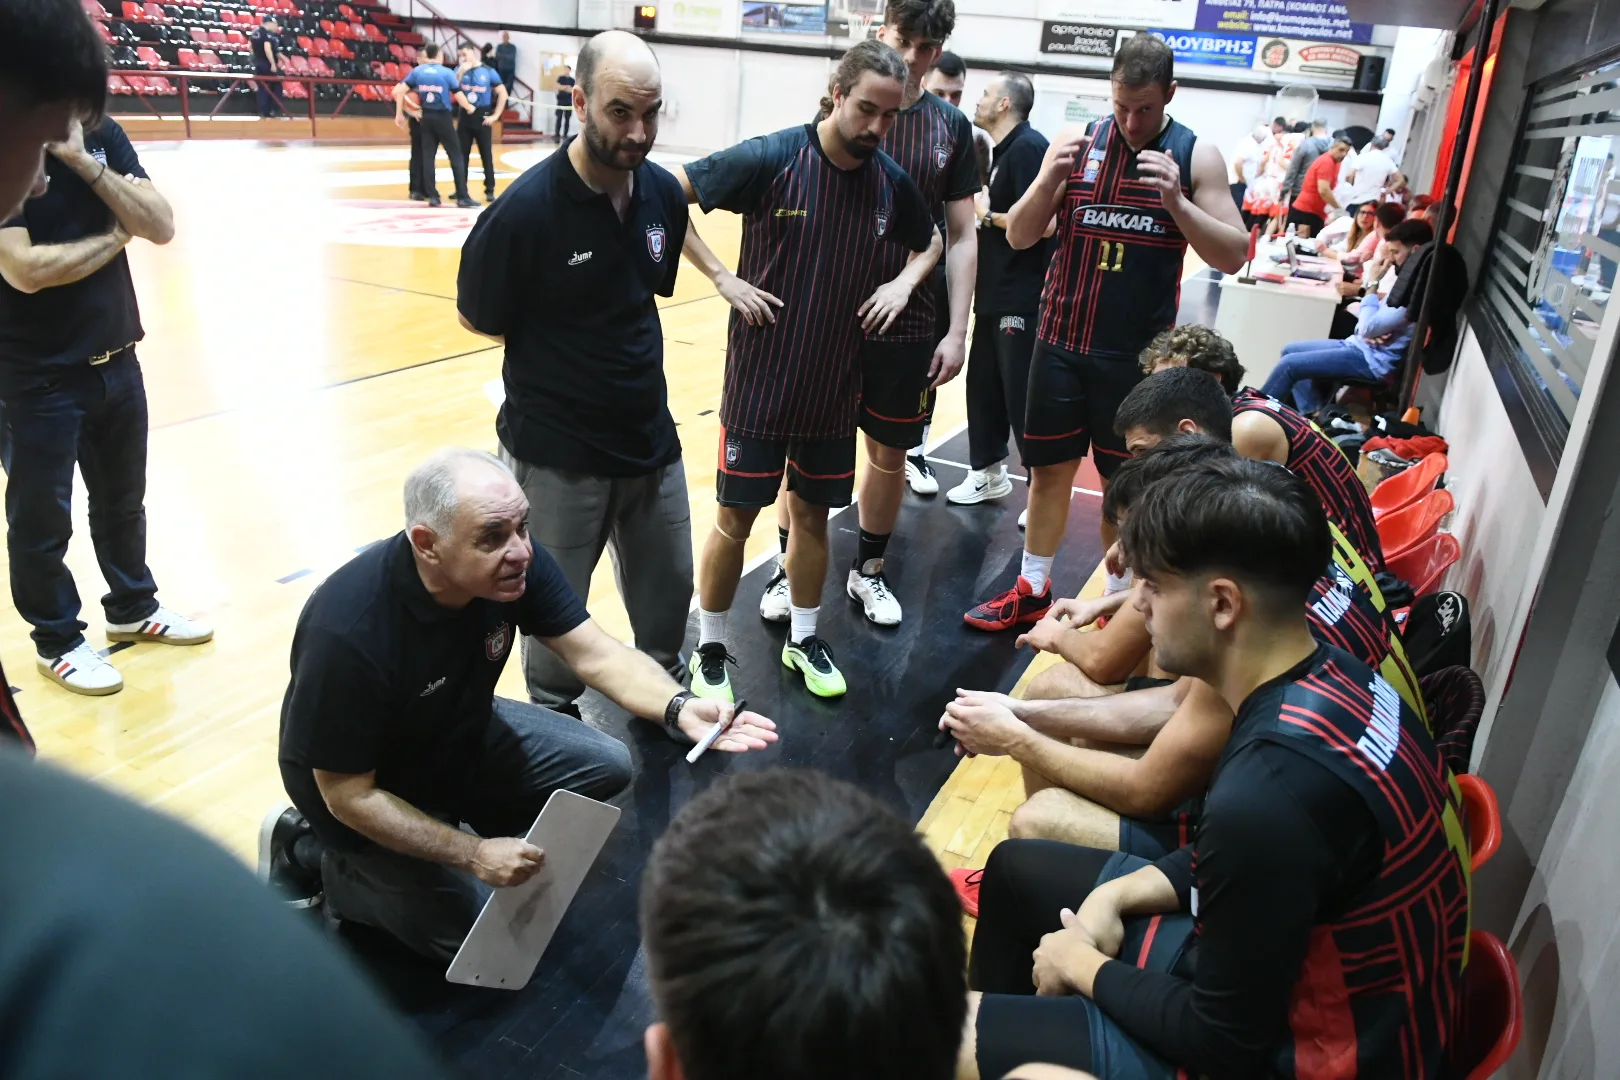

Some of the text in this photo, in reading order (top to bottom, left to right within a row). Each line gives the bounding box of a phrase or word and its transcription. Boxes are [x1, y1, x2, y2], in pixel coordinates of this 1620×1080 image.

[1223, 10, 1249, 20] email:
[1082, 208, 1154, 232] BAKKAR
[1098, 240, 1124, 272] 11
